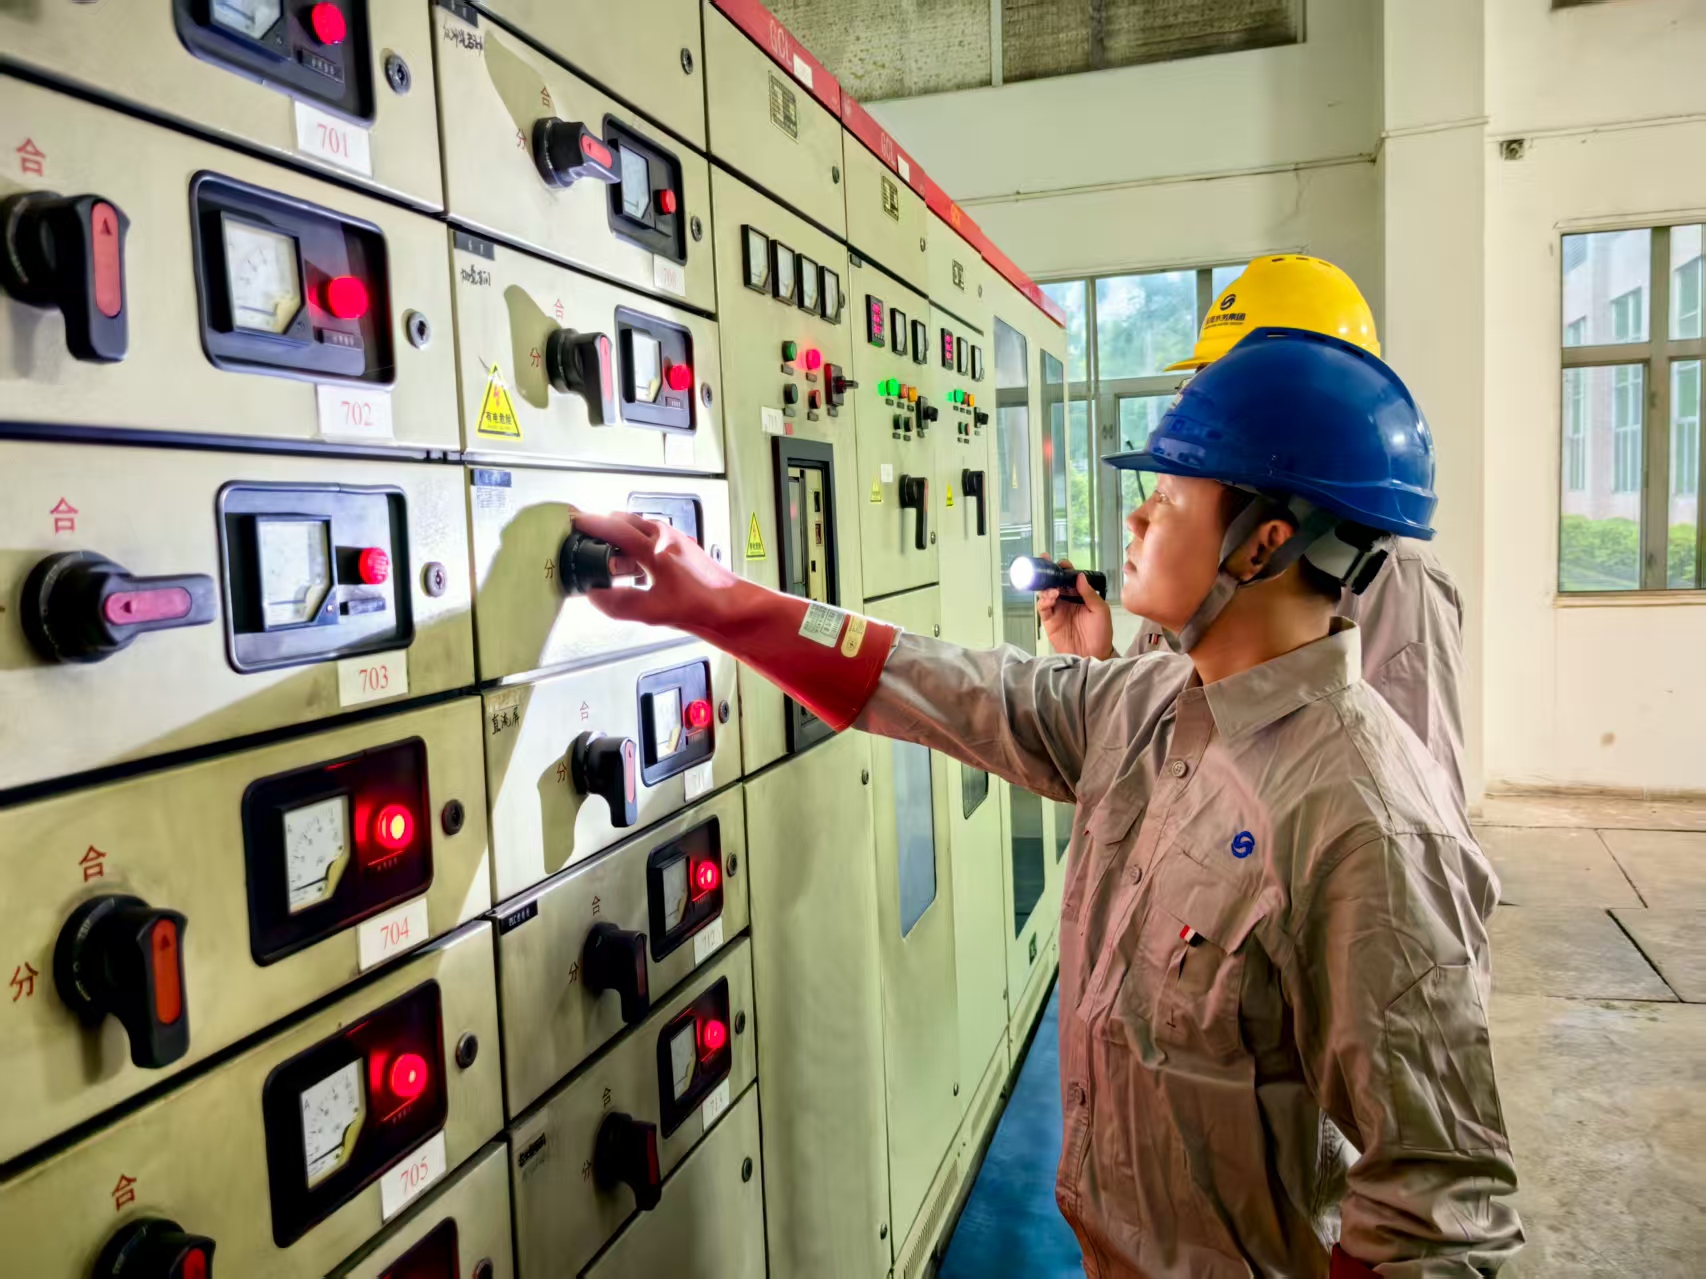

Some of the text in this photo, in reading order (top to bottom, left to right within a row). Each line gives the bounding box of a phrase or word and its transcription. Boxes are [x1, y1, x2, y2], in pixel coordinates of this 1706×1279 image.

[540, 87, 551, 107] 合
[317, 123, 350, 158] 701
[516, 128, 527, 151] 分
[16, 137, 46, 177] 合
[554, 299, 564, 320] 合
[529, 347, 541, 368] 分
[340, 401, 374, 425] 702
[49, 497, 79, 534] 合
[544, 558, 555, 579] 分
[358, 664, 389, 692] 703
[580, 700, 590, 720] 合
[556, 763, 567, 783] 分
[79, 845, 107, 882] 合
[591, 896, 600, 915] 合
[380, 917, 409, 950] 704
[10, 962, 39, 1002] 分
[569, 962, 579, 983] 分
[603, 1087, 611, 1109] 合
[401, 1156, 429, 1194] 705
[582, 1159, 592, 1182] 分
[112, 1174, 137, 1211] 合
